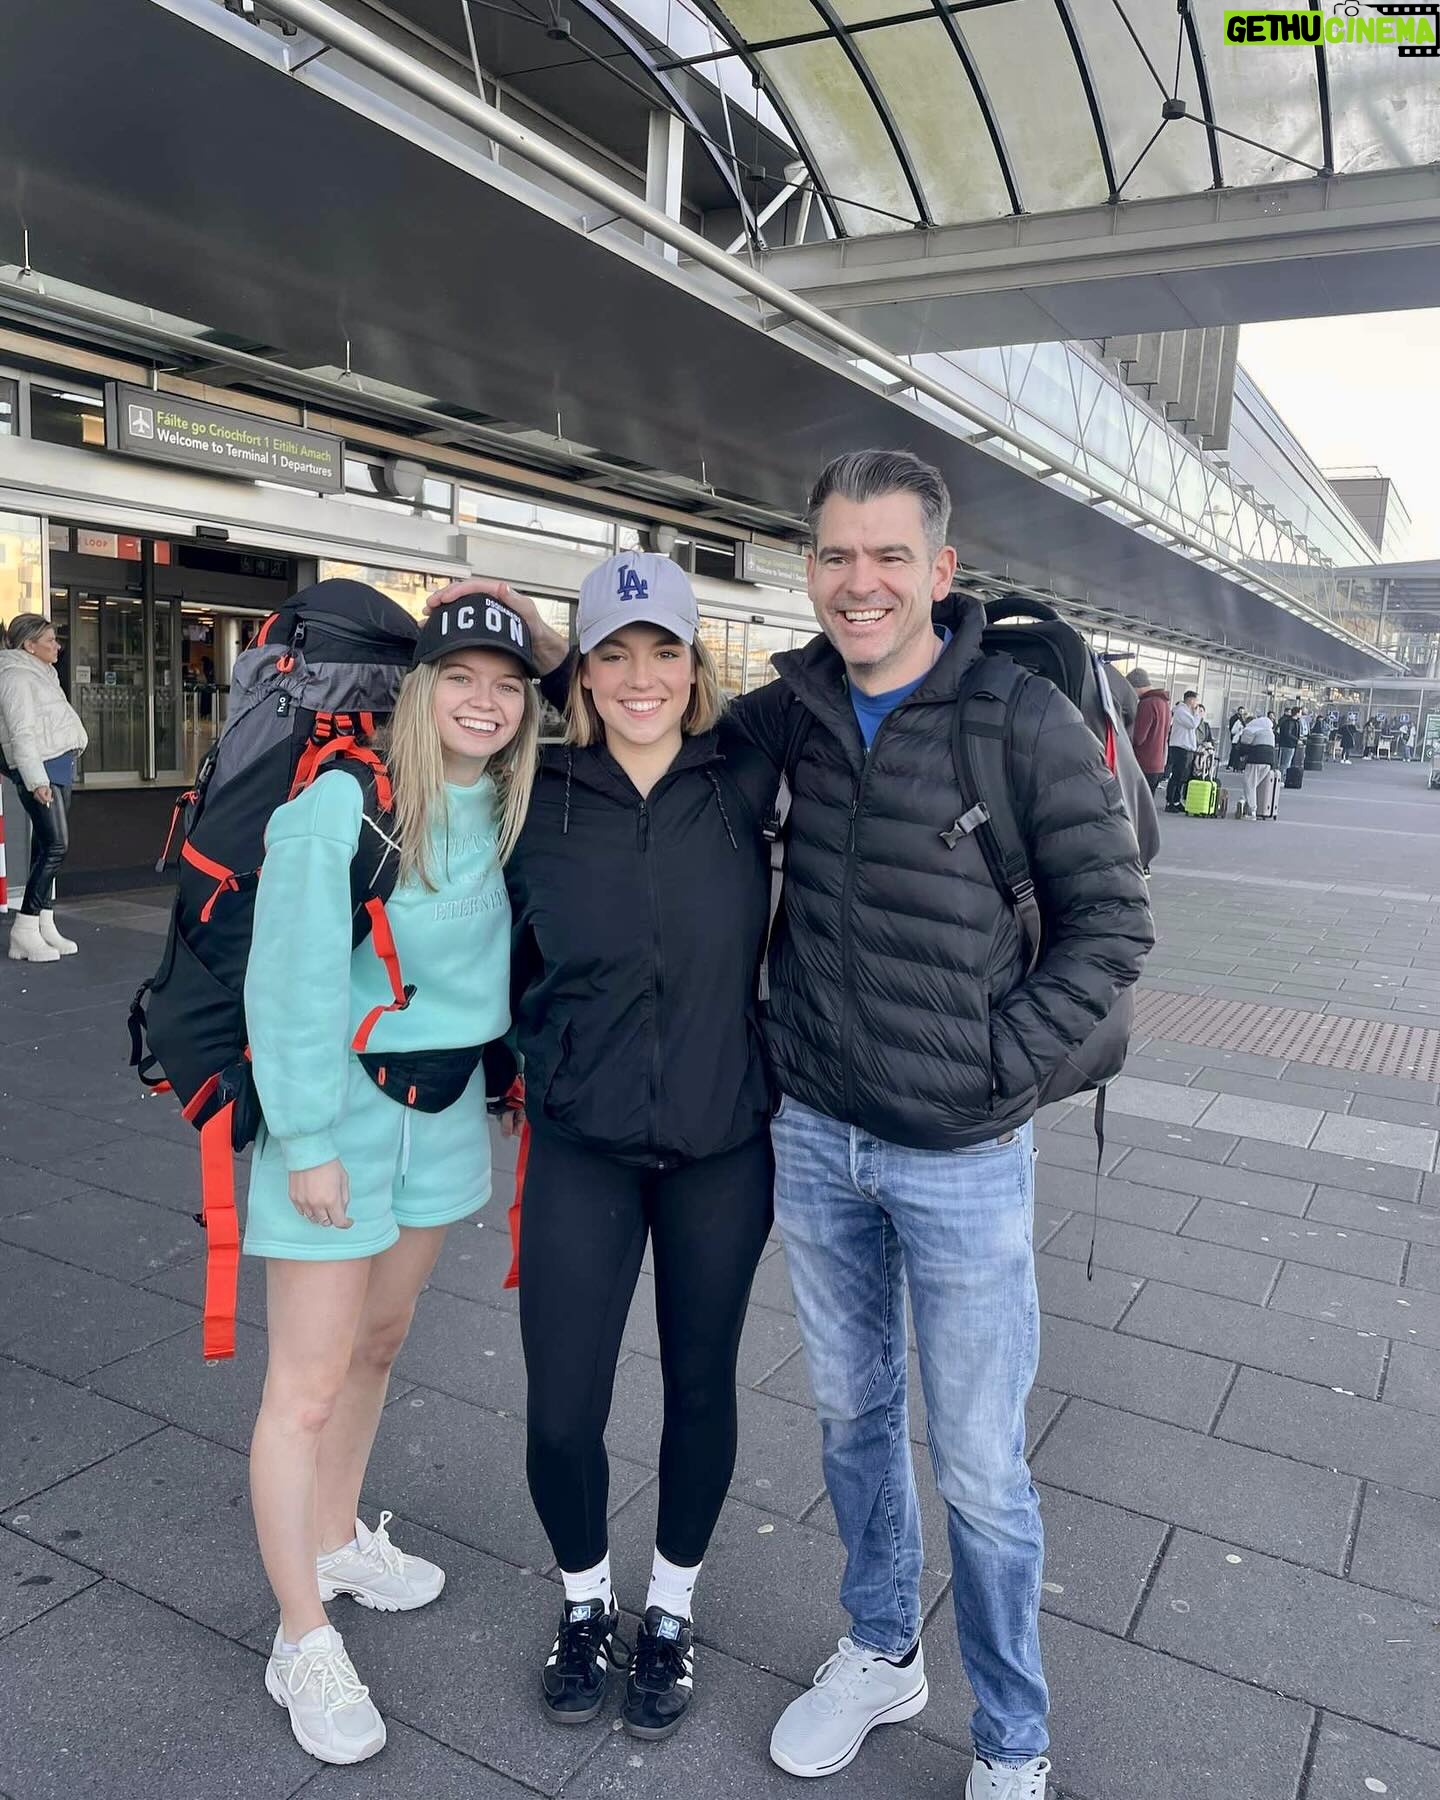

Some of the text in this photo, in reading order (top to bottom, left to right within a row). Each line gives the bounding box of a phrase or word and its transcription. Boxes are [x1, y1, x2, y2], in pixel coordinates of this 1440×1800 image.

[156, 410, 189, 430] Fáilte
[191, 422, 207, 435] go
[209, 423, 261, 447] Criochfort
[264, 436, 270, 448] 1
[300, 444, 332, 462] Amach
[156, 427, 333, 477] Welcome to Terminal 1 Departures
[85, 539, 108, 549] LOOP
[617, 564, 649, 601] LA
[441, 606, 524, 648] ICON
